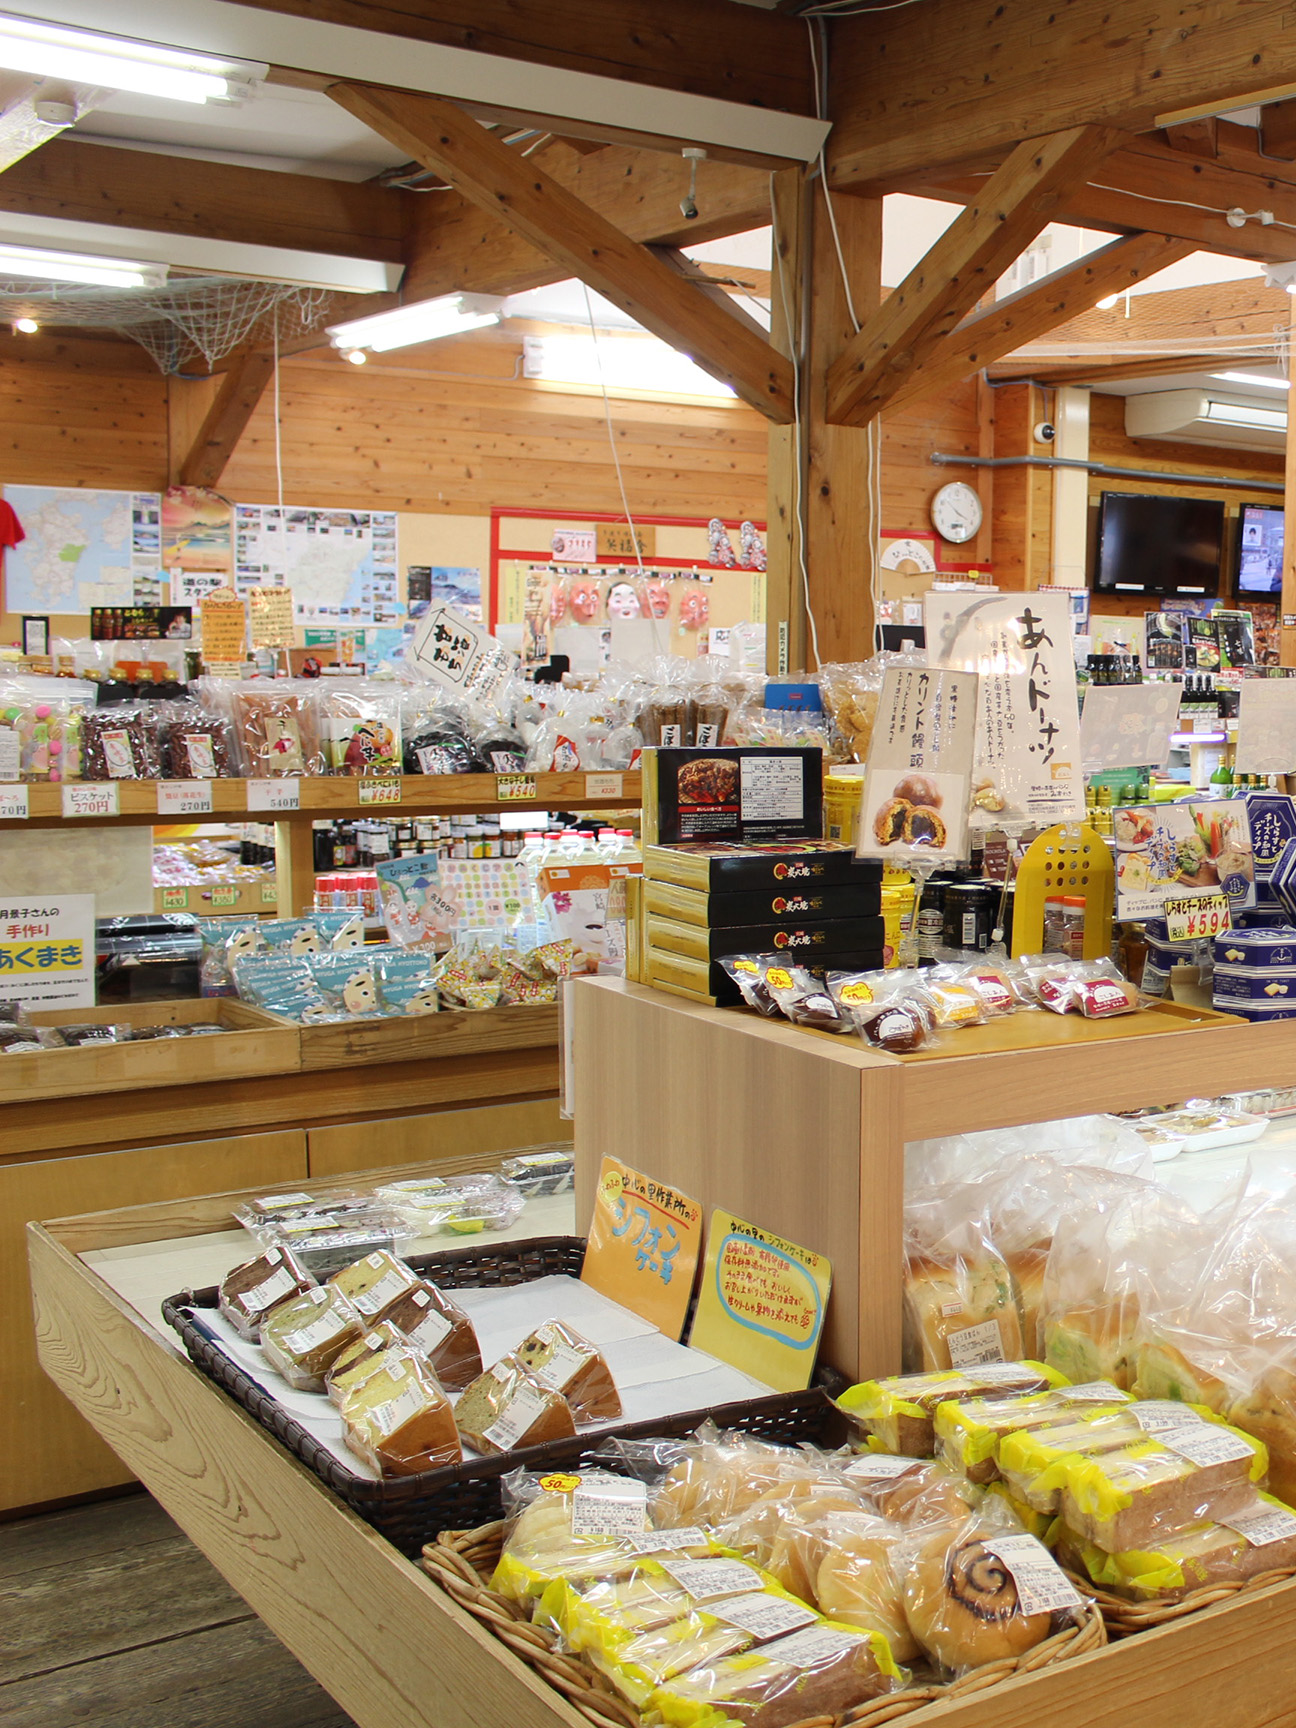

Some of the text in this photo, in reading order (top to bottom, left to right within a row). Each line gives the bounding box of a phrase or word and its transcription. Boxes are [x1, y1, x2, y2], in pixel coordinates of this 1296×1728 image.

[183, 578, 222, 588] 道の駅
[1016, 607, 1060, 765] あんドーナツ
[71, 791, 114, 802] ビスケット
[371, 788, 400, 802] ¥648
[508, 785, 536, 798] ¥540
[74, 801, 109, 813] 270円
[180, 801, 210, 811] 270円
[270, 798, 299, 808] 540円
[6, 923, 49, 939] 手作り
[1187, 911, 1230, 937] ¥594
[0, 945, 82, 969] あくまき
[612, 1196, 680, 1260] シフォン
[635, 1248, 673, 1285] ケーキ
